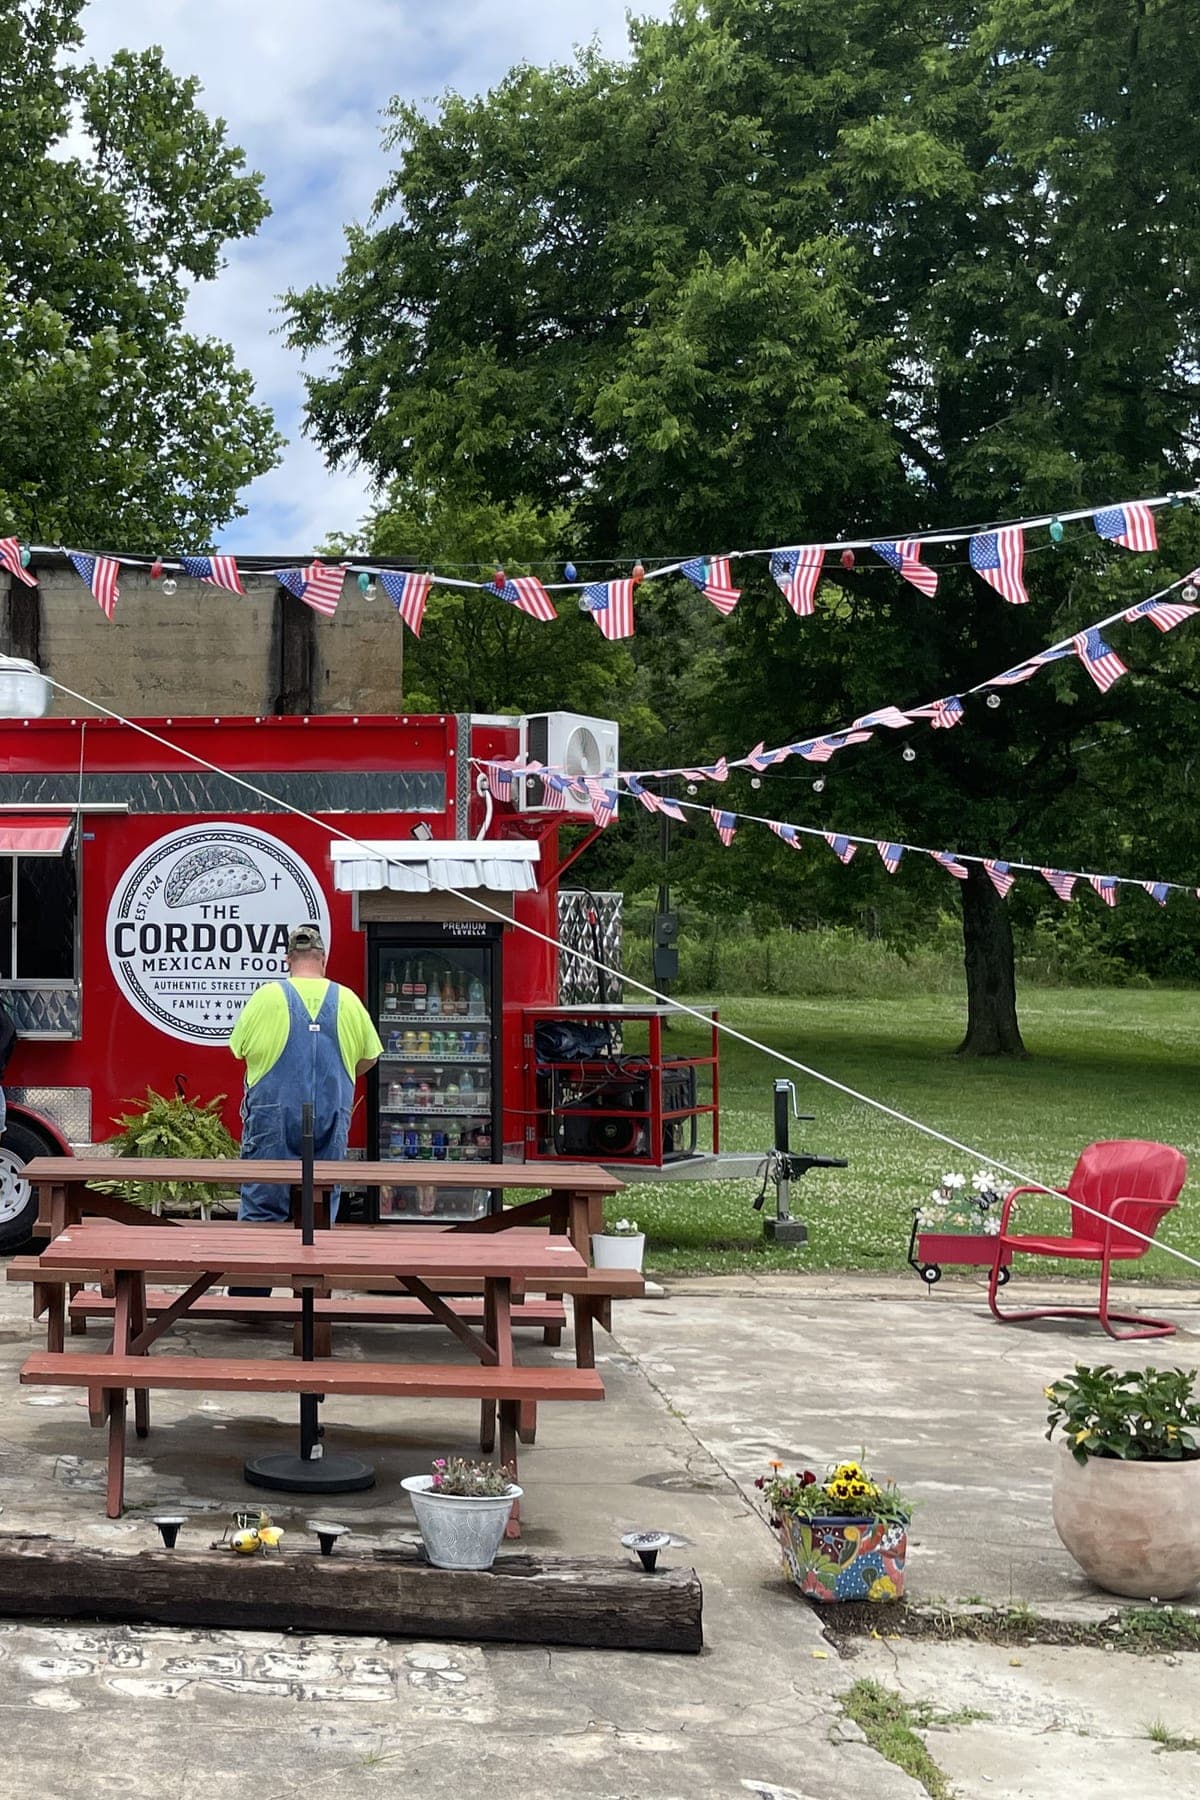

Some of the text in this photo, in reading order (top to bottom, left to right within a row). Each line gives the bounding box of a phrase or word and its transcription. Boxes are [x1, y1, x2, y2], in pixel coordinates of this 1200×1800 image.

[135, 875, 163, 921] EST. 2024
[200, 905, 240, 919] THE
[442, 920, 486, 930] PREMIUM
[114, 922, 320, 957] CORDOVA
[142, 956, 290, 973] MEXICAN FOOD
[154, 981, 207, 990] AUTHENTIC
[211, 982, 246, 990] STREET
[172, 1000, 211, 1008] FAMILY
